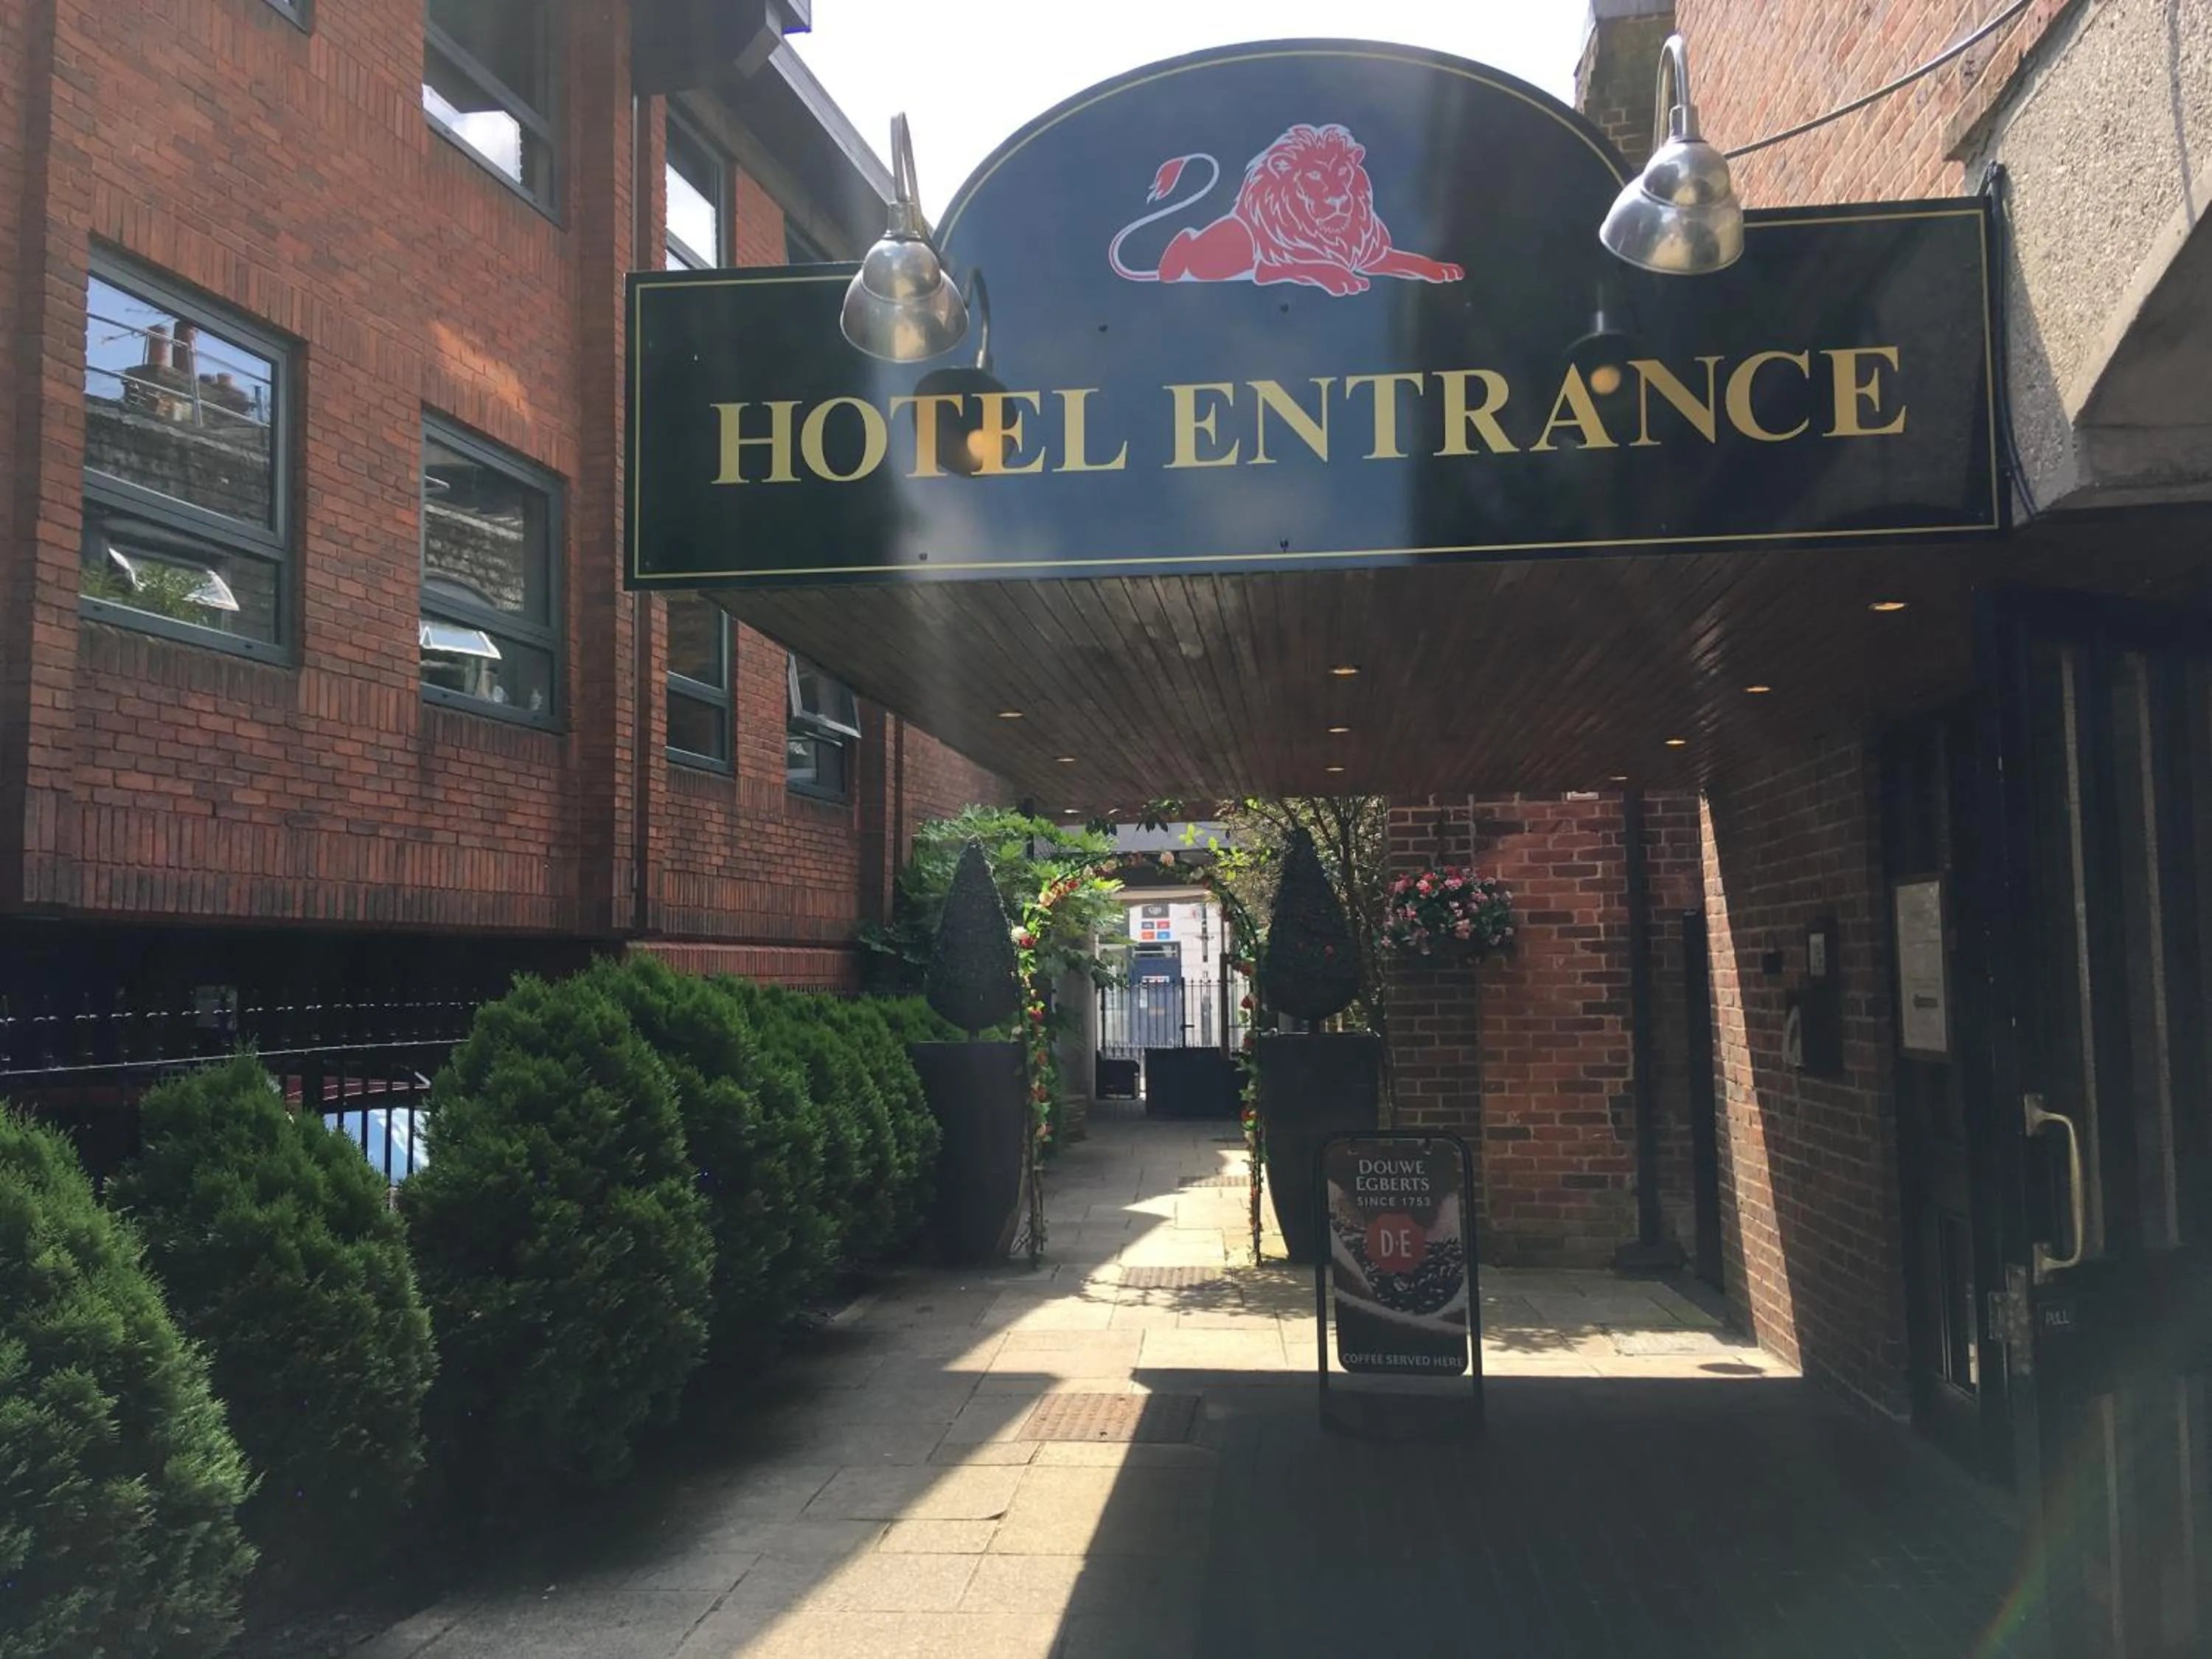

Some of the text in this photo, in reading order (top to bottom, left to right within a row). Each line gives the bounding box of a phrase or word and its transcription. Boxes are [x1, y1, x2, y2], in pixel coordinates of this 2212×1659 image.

[709, 345, 1907, 484] HOTEL ENTRANCE
[1358, 1159, 1425, 1175] DOUWE
[1356, 1175, 1430, 1191] EGBERTS
[1357, 1196, 1431, 1207] SINCE 1753
[1343, 1352, 1464, 1368] COFFEE SERVED HERE
